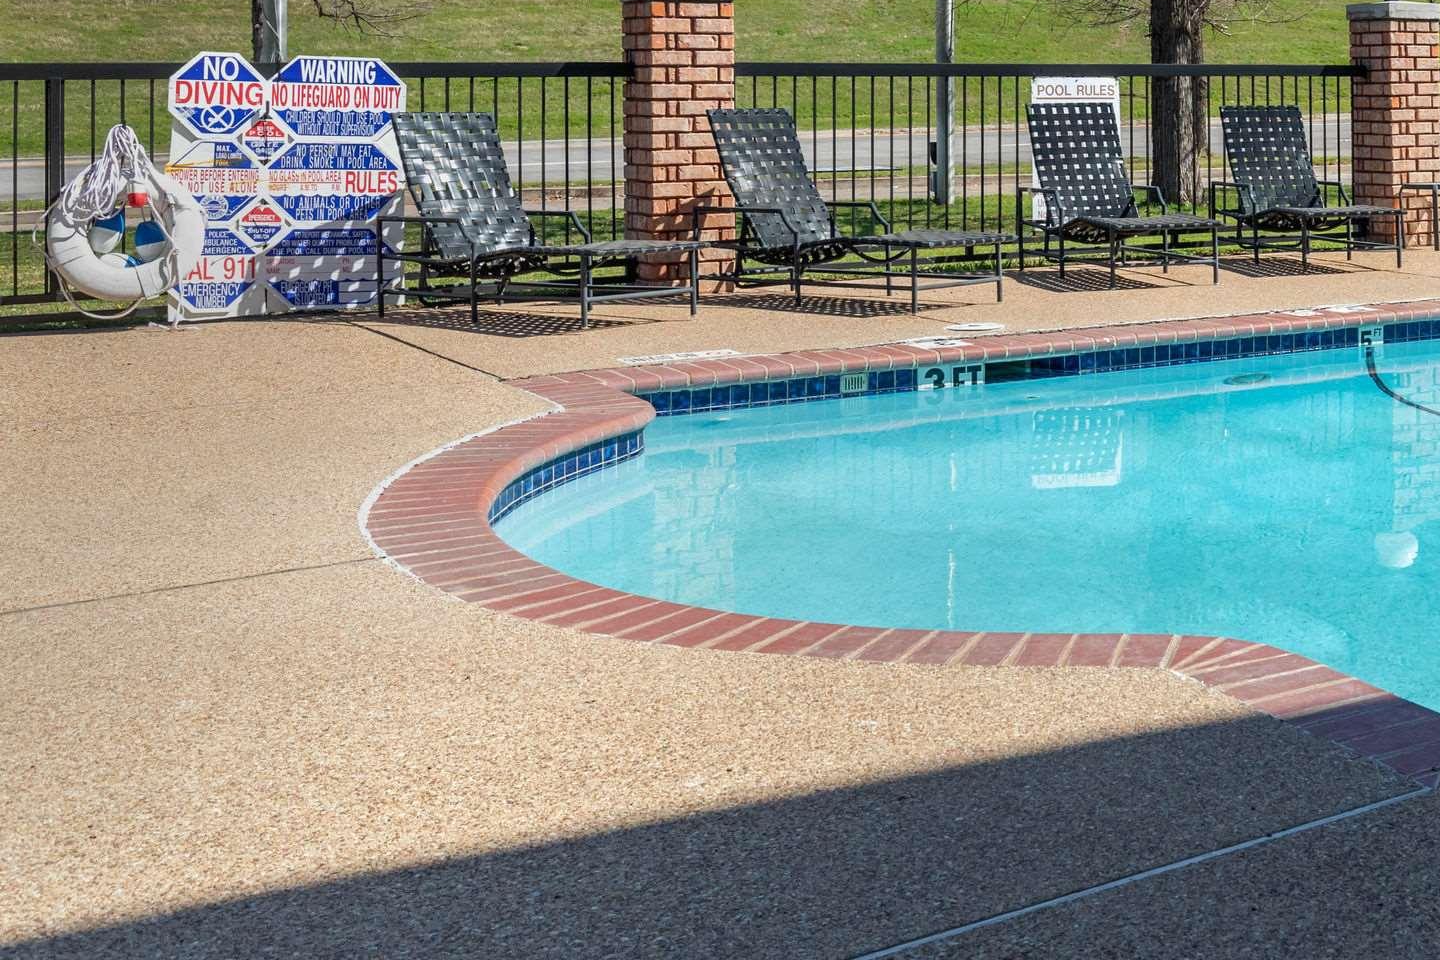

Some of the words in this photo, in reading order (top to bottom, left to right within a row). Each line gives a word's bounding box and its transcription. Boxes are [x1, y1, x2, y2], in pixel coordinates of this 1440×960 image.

[203, 56, 240, 81] NO
[300, 59, 377, 84] WARNING
[175, 80, 263, 106] DIVING
[271, 83, 288, 106] NO
[292, 84, 350, 108] LIFEGUARD
[354, 86, 370, 109] ON
[374, 86, 401, 109] DUTY
[1037, 84, 1072, 97] POOL
[1076, 84, 1115, 97] RULES
[286, 111, 316, 123] CHILDREN
[317, 111, 341, 124] SHOULD
[343, 112, 355, 124] NOT
[356, 112, 368, 124] USE
[369, 113, 384, 125] POOL
[297, 123, 321, 136] WITHOUT
[322, 123, 340, 136] ADULT
[340, 123, 375, 137] SUPERVISION
[296, 145, 307, 156] NO
[310, 145, 338, 157] PERSON
[341, 145, 356, 157] MAY
[359, 146, 372, 157] EAT
[309, 157, 335, 169] SMOKE
[337, 157, 344, 169] IN
[347, 157, 366, 169] POOL
[369, 157, 388, 169] AREA
[200, 170, 226, 181] BEFORE
[228, 170, 259, 182] ENTERING
[269, 171, 278, 181] NO
[280, 171, 299, 181] GLASS
[301, 171, 307, 181] IN
[308, 171, 324, 182] POOL
[326, 171, 341, 182] AREA
[345, 171, 398, 193] RULES
[188, 182, 205, 193] NOT
[209, 182, 225, 193] USE
[229, 182, 258, 193] ALONE
[283, 197, 295, 209] NO
[299, 197, 335, 209] ANIMALS
[339, 197, 350, 209] OR
[354, 197, 381, 209] OTHER
[295, 209, 314, 220] PETS
[316, 209, 325, 220] IN
[327, 209, 345, 221] POOL
[349, 209, 368, 221] AREA
[183, 257, 215, 280] AL
[223, 257, 256, 280] 911
[182, 283, 241, 297] EMERGENCY
[195, 296, 226, 308] NUMBER
[1361, 330, 1373, 346] 5
[1374, 328, 1383, 337] FT
[924, 367, 946, 390] 3
[952, 363, 982, 387] FT
